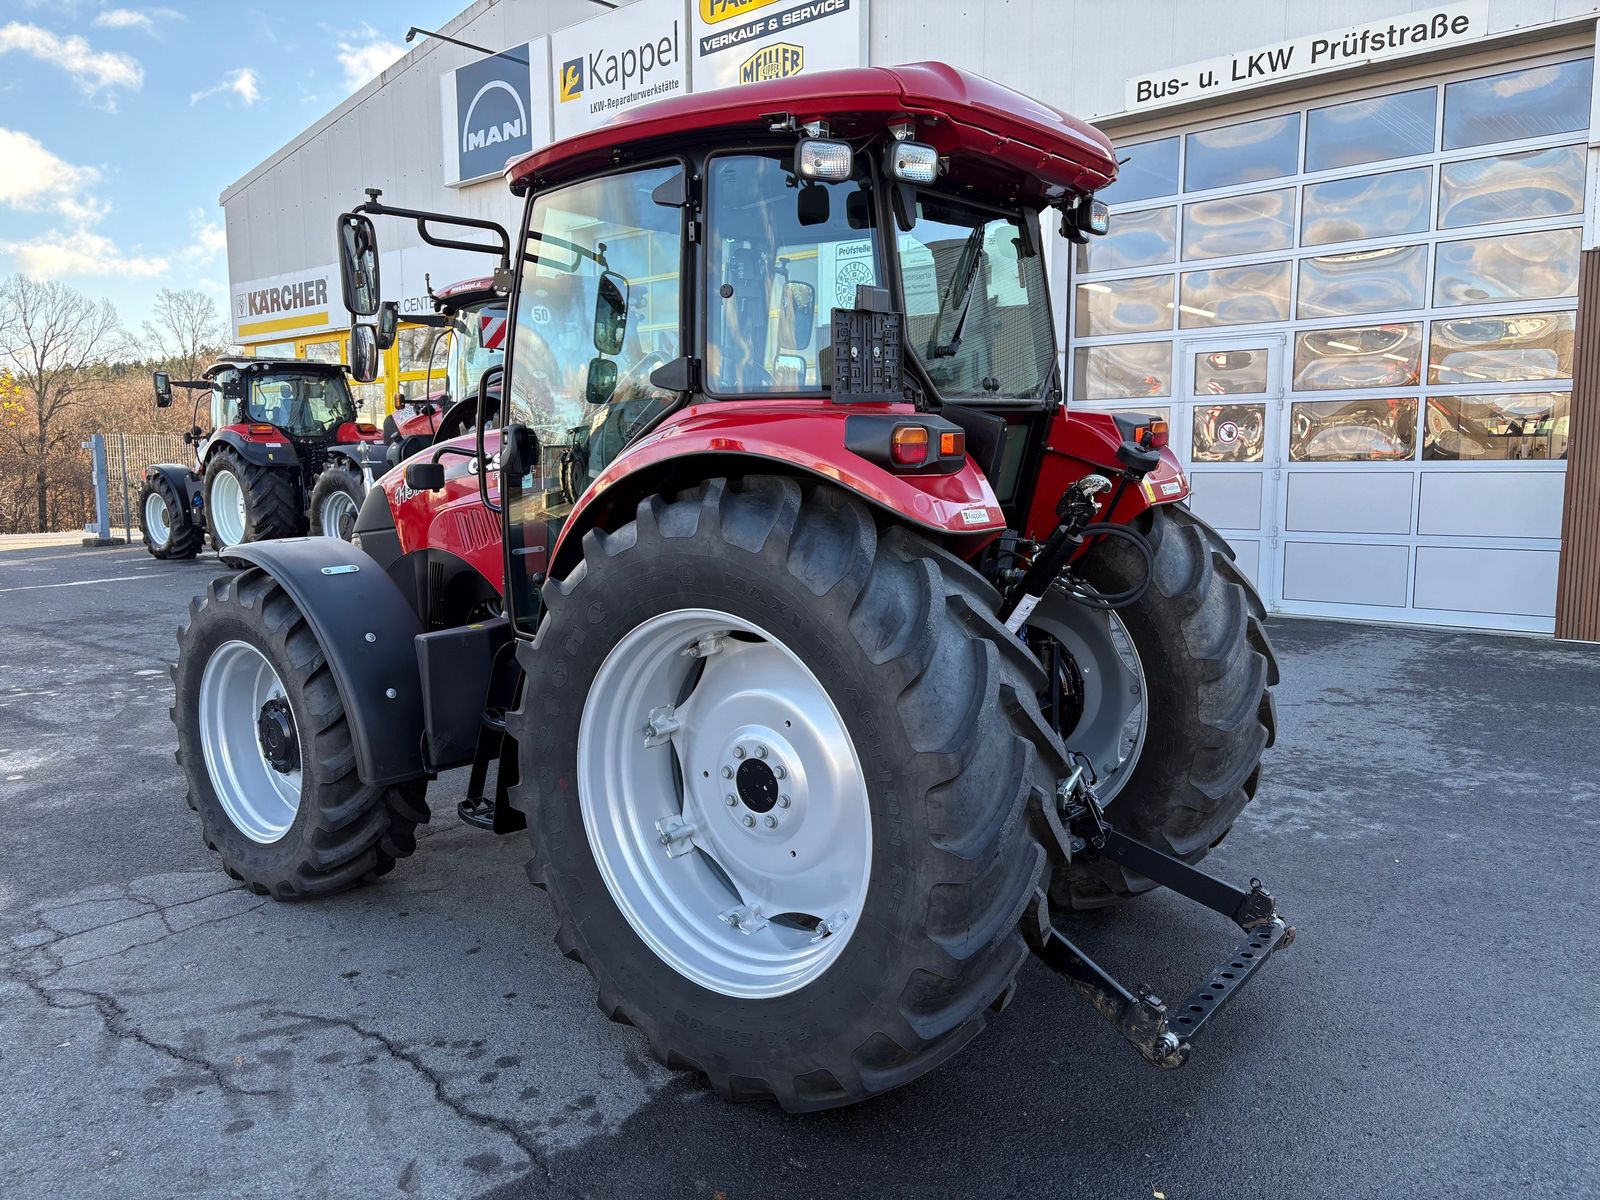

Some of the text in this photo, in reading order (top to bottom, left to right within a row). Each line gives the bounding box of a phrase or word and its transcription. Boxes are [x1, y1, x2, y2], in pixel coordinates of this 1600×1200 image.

[703, 0, 845, 51] VERKAUF & SERVICE
[589, 20, 678, 90] Kappel
[1137, 13, 1469, 102] Bus- u. LKW Prüfstraße
[590, 79, 679, 114] LKW-Reparaturwerkstätte
[468, 118, 522, 151] MAN
[838, 244, 871, 256] Prüfstelle
[248, 279, 328, 316] KÄRCHER
[403, 296, 435, 313] CENTE
[534, 308, 548, 321] 50
